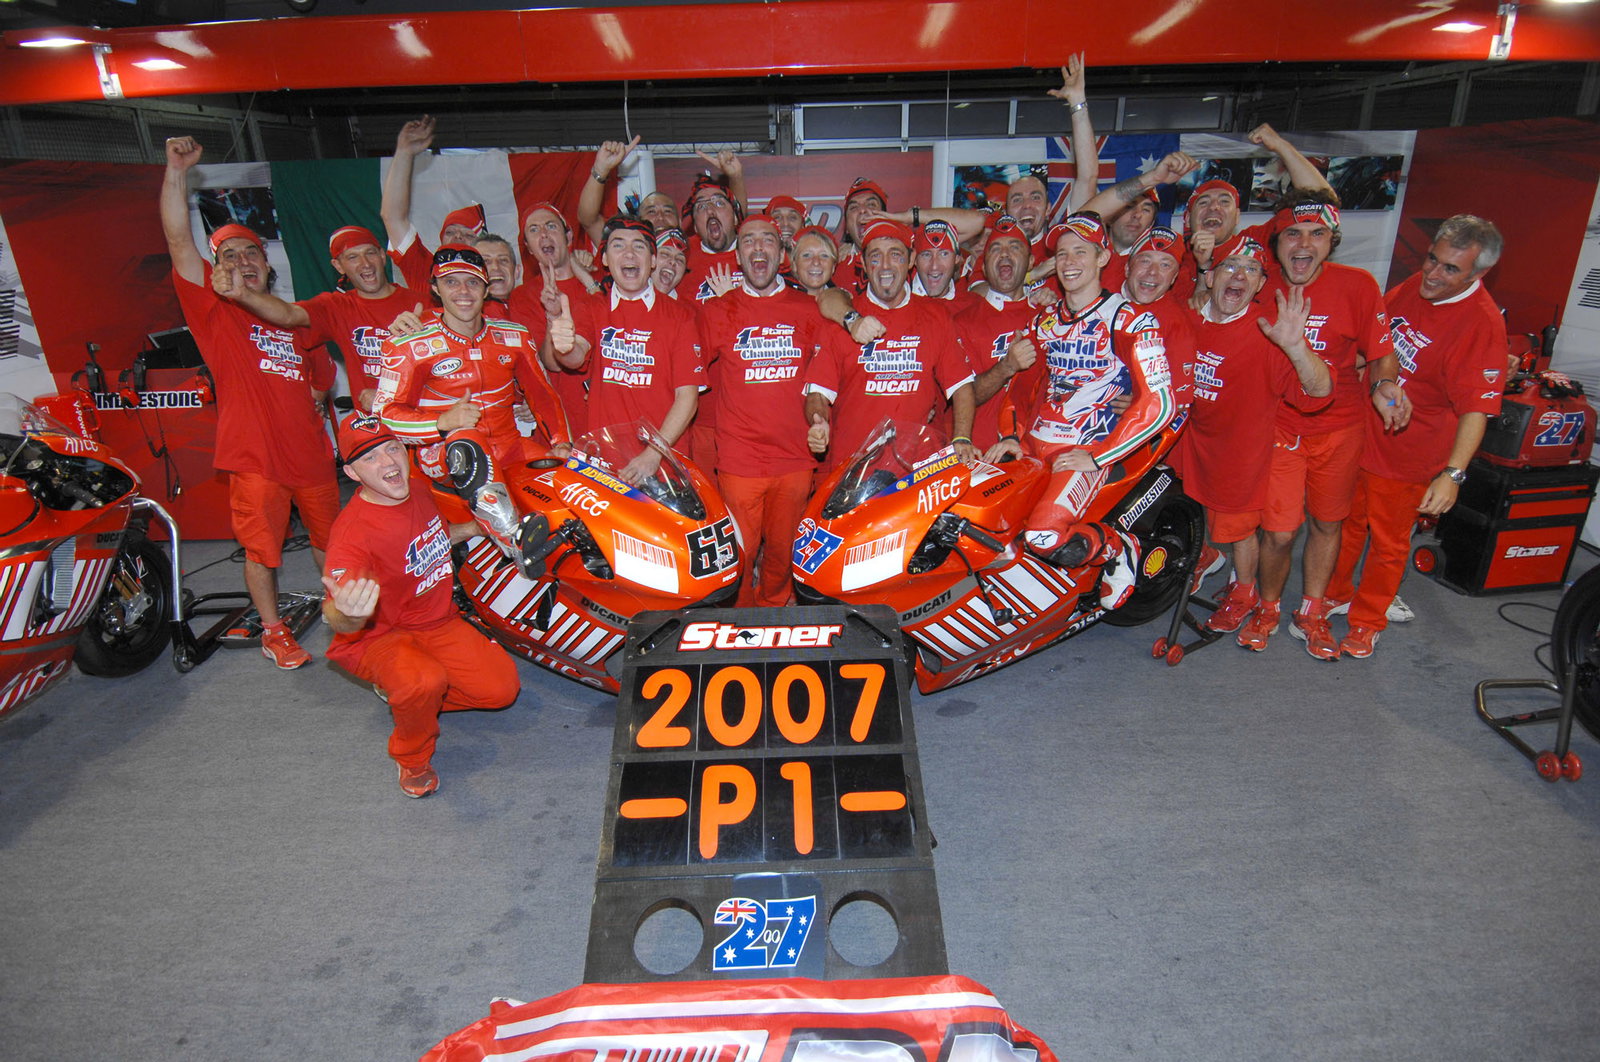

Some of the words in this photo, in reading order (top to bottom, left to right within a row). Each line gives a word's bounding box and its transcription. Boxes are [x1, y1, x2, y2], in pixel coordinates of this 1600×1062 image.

[741, 348, 801, 360] Champion
[749, 336, 793, 350] World
[874, 349, 916, 362] World
[603, 367, 652, 385] DUCATI
[745, 367, 798, 380] DUCATI
[864, 361, 922, 373] Champion
[865, 380, 920, 392] DUCATI
[1533, 411, 1585, 446] 27
[578, 467, 632, 494] ADVANCE
[913, 454, 960, 484] ADVANCE
[522, 485, 553, 503] DUCATI
[560, 482, 610, 516] Alice
[917, 476, 961, 514] Alice
[982, 478, 1015, 498] DUCATI
[1118, 473, 1172, 531] BRIDGESTONE
[685, 516, 739, 580] 65
[791, 518, 844, 575] 27
[1504, 545, 1560, 559] Stoner
[415, 561, 453, 595] DUCA
[580, 598, 629, 626] DUCATI
[902, 590, 952, 622] DUCATI
[678, 621, 843, 651] Stoner
[636, 664, 885, 747] 2007
[712, 895, 816, 970] 27
